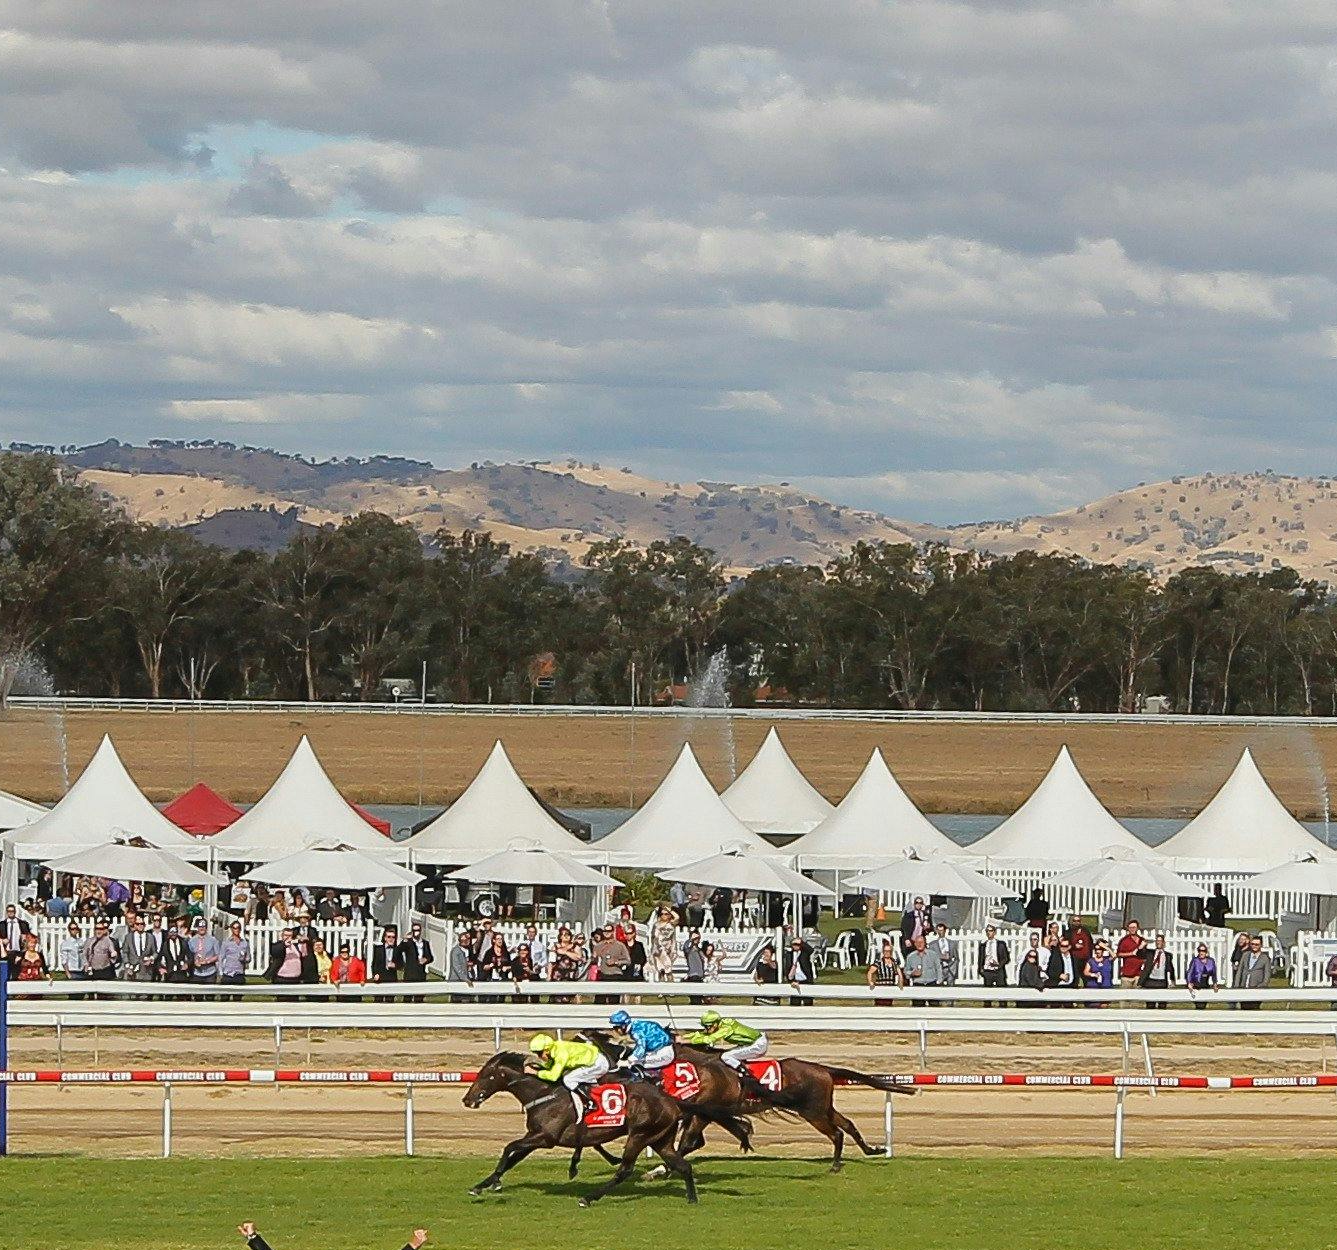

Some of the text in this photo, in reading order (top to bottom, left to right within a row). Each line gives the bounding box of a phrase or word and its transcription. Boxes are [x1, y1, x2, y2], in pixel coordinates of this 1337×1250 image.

[675, 1062, 693, 1088] 5
[759, 1065, 778, 1091] 4
[601, 1089, 622, 1114] 6
